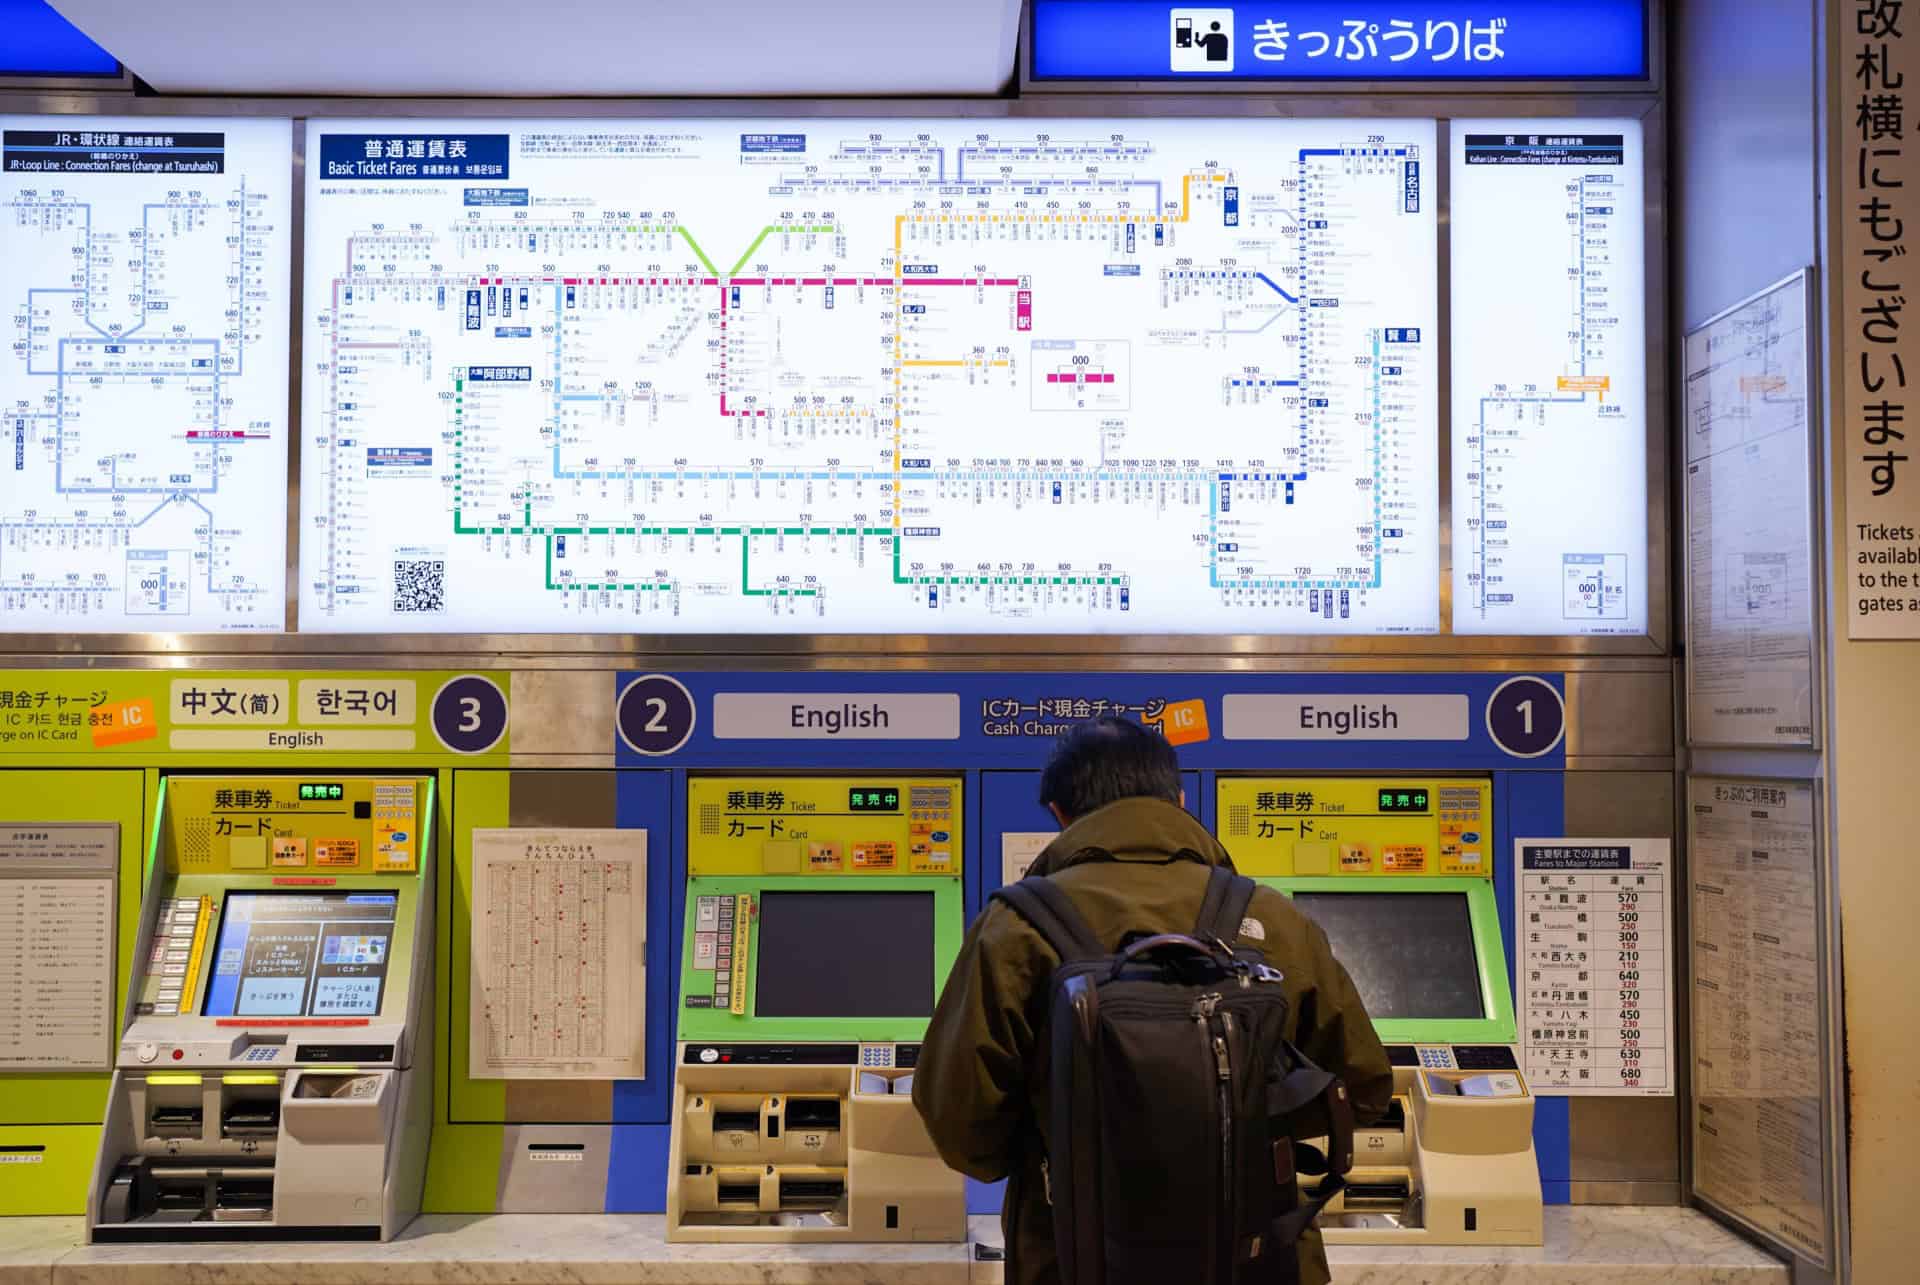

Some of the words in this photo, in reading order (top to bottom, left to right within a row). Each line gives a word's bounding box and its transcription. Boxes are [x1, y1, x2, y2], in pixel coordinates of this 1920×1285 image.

[1252, 18, 1507, 61] きっぷうりば
[55, 133, 120, 146] JR・環状線
[868, 134, 882, 142] 930
[916, 134, 930, 142] 900
[1368, 135, 1384, 143] 2290
[364, 140, 467, 158] 普通運賃表
[44, 160, 60, 170] Line
[65, 160, 108, 170] Connection
[111, 161, 131, 170] Fares
[132, 161, 163, 172] (change
[165, 162, 173, 171] at
[174, 161, 218, 172] Tsuruhashi)
[328, 161, 354, 175] Basic
[356, 161, 389, 175] Ticket
[390, 161, 417, 175] Fares
[1204, 161, 1218, 169] 640
[20, 190, 38, 198] 1060
[1078, 201, 1092, 209] 500
[572, 211, 584, 219] 770
[662, 211, 676, 219] 470
[1280, 226, 1298, 234] 2050
[1856, 0, 1908, 496] 改札横にもございます
[880, 258, 894, 266] 210
[1176, 258, 1192, 266] 2080
[486, 264, 500, 272] 570
[542, 264, 556, 272] 500
[598, 264, 610, 272] 450
[974, 265, 986, 273] 160
[72, 275, 86, 283] 810
[226, 276, 240, 284] 720
[1072, 356, 1090, 365] 000
[634, 382, 652, 390] 1200
[438, 392, 454, 400] 1020
[1282, 397, 1300, 405] 1720
[1354, 413, 1372, 421] 2110
[624, 458, 636, 466] 700
[826, 459, 840, 467] 500
[1248, 460, 1264, 468] 1470
[112, 495, 126, 503] 660
[1466, 519, 1480, 527] 910
[1857, 523, 1914, 541] Tickets
[880, 537, 894, 545] 500
[1022, 563, 1034, 571] 730
[1354, 567, 1370, 575] 1840
[604, 570, 618, 578] 900
[1858, 572, 1876, 587] to
[1880, 570, 1908, 587] the
[140, 580, 158, 589] 000
[232, 576, 244, 584] 720
[1578, 584, 1596, 592] 000
[1859, 596, 1903, 615] gates
[182, 687, 279, 716] 中文(简)
[316, 689, 398, 717] 한국어
[983, 699, 1166, 719] ICカード現金チャージ
[6, 713, 20, 725] IC
[27, 713, 52, 726] 카드
[58, 713, 82, 726] 현금
[88, 713, 113, 726] 충전
[122, 706, 143, 726] IC
[458, 697, 482, 733] 3
[644, 697, 669, 733] 2
[791, 704, 889, 734] English
[1173, 708, 1195, 728] IC
[1299, 705, 1399, 735] English
[1515, 699, 1533, 734] 1
[984, 721, 1019, 736] Cash
[19, 731, 35, 740] on
[38, 730, 49, 740] IC
[52, 730, 77, 740] Card
[268, 732, 324, 749] English
[300, 786, 341, 798] 発売中
[215, 790, 272, 809] 乗車券
[275, 801, 300, 810] Ticket
[727, 791, 785, 811] 乗車券
[791, 802, 816, 812] Ticket
[851, 793, 897, 806] 発売中
[1256, 792, 1314, 812] 乗車券
[1320, 803, 1345, 813] Ticket
[1381, 794, 1426, 807] 発売中
[215, 817, 272, 837] カード
[728, 819, 785, 838] カード
[1257, 820, 1314, 840] カード
[1535, 849, 1619, 858] 主要駅までの運賃表
[1618, 893, 1638, 903] 570
[1618, 913, 1639, 923] 500
[1618, 932, 1639, 942] 300
[1619, 952, 1639, 962] 210
[1619, 971, 1640, 981] 640
[1619, 990, 1640, 1000] 570
[1619, 1010, 1640, 1020] 450
[1620, 1029, 1641, 1039] 500
[1620, 1049, 1641, 1059] 630
[1620, 1069, 1641, 1079] 680
